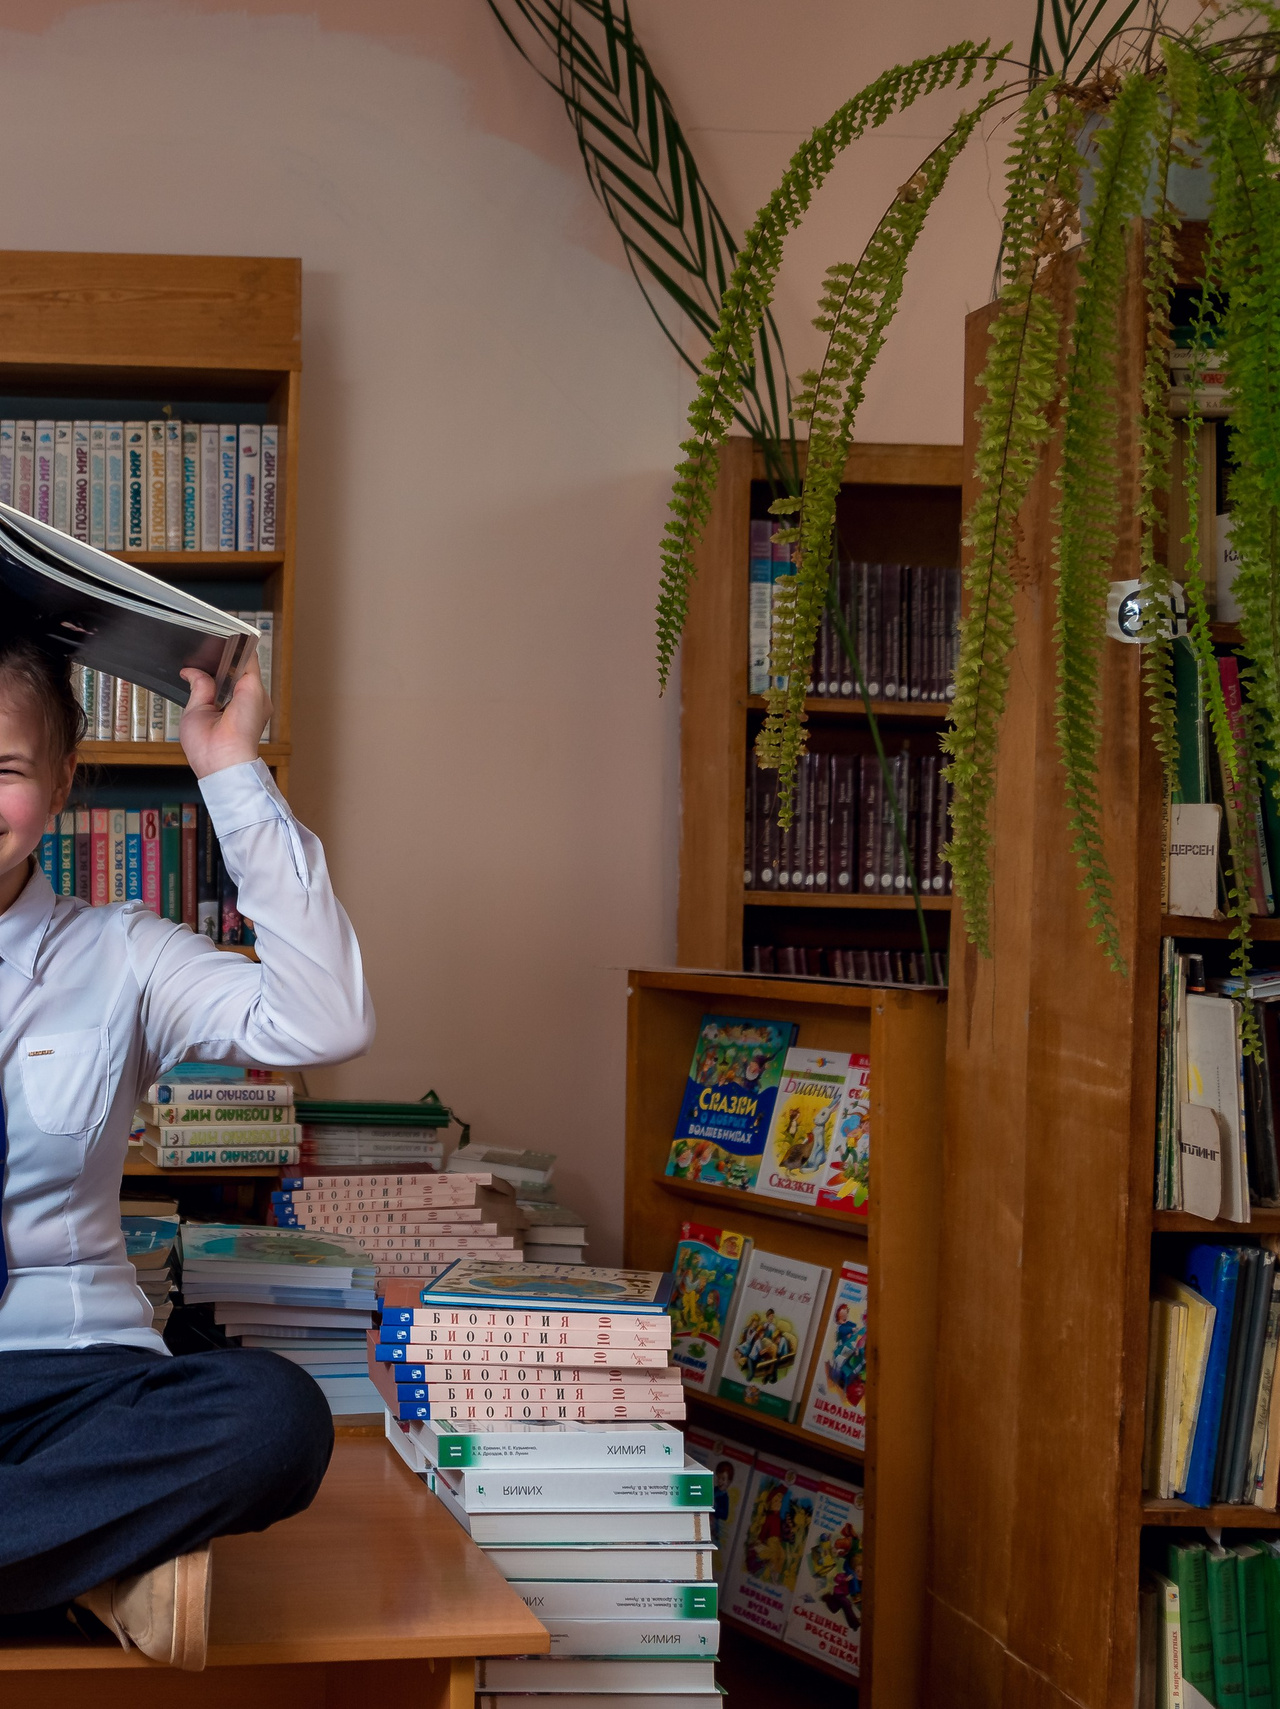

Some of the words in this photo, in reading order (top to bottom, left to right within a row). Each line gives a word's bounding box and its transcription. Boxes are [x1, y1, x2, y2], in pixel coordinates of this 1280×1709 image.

[130, 448, 141, 478] МИР
[265, 451, 275, 478] МИР
[39, 484, 50, 523] ОЗНАЮ
[130, 481, 141, 534] ПОЗНАЮ
[263, 482, 275, 535] ПОЗНАЮ
[129, 537, 141, 547] Я
[62, 839, 71, 869] ВСЕХ
[97, 840, 105, 870] ВСЕХ
[115, 840, 123, 870] ВСЕХ
[129, 838, 137, 868] ВСЕХ
[147, 842, 155, 871] ВСЕХ
[62, 872, 70, 896] ОБО
[97, 874, 105, 897] ОБО
[115, 873, 123, 897] ОБО
[129, 872, 137, 895] ОБО
[784, 1072, 841, 1100] Бианки
[181, 1109, 210, 1121] МИР
[215, 1108, 269, 1121] ПОЗНАЮ
[186, 1151, 216, 1163] МИР
[220, 1150, 275, 1163] ПОЗНАЮ
[438, 1175, 448, 1184] 10
[769, 1174, 816, 1194] Сказки
[306, 1187, 402, 1201] БИОЛОГИЯ
[423, 1185, 433, 1194] 10
[307, 1199, 403, 1213] БИОЛОГИЯ
[423, 1197, 433, 1206] 10
[359, 1238, 435, 1248] ОЛОГИЯ
[368, 1252, 444, 1262] ОЛОГИЯ
[433, 1312, 570, 1328] БИОЛОГИЯ
[430, 1330, 568, 1345] БИОЛОГИЯ
[426, 1348, 564, 1363] БИОЛОГИЯ
[445, 1368, 581, 1382] БИОЛОГИЯ
[448, 1388, 584, 1401] БИОЛОГИЯ
[450, 1405, 585, 1418] БИОЛОГИЯ
[814, 1398, 866, 1425] ШКОЛЬНЫ
[450, 1446, 461, 1457] 11
[607, 1445, 646, 1455] ХИМИЯ
[503, 1486, 543, 1496] ХИМИЯ
[690, 1485, 702, 1495] 11
[522, 1597, 544, 1606] ХИМ
[793, 1605, 849, 1638] СМЕШНЫЕ
[641, 1635, 680, 1643] ХИМИЯ
[829, 1645, 859, 1667] ШКОЛ
[1171, 1631, 1179, 1670] животных
[1173, 1671, 1181, 1690] мире
